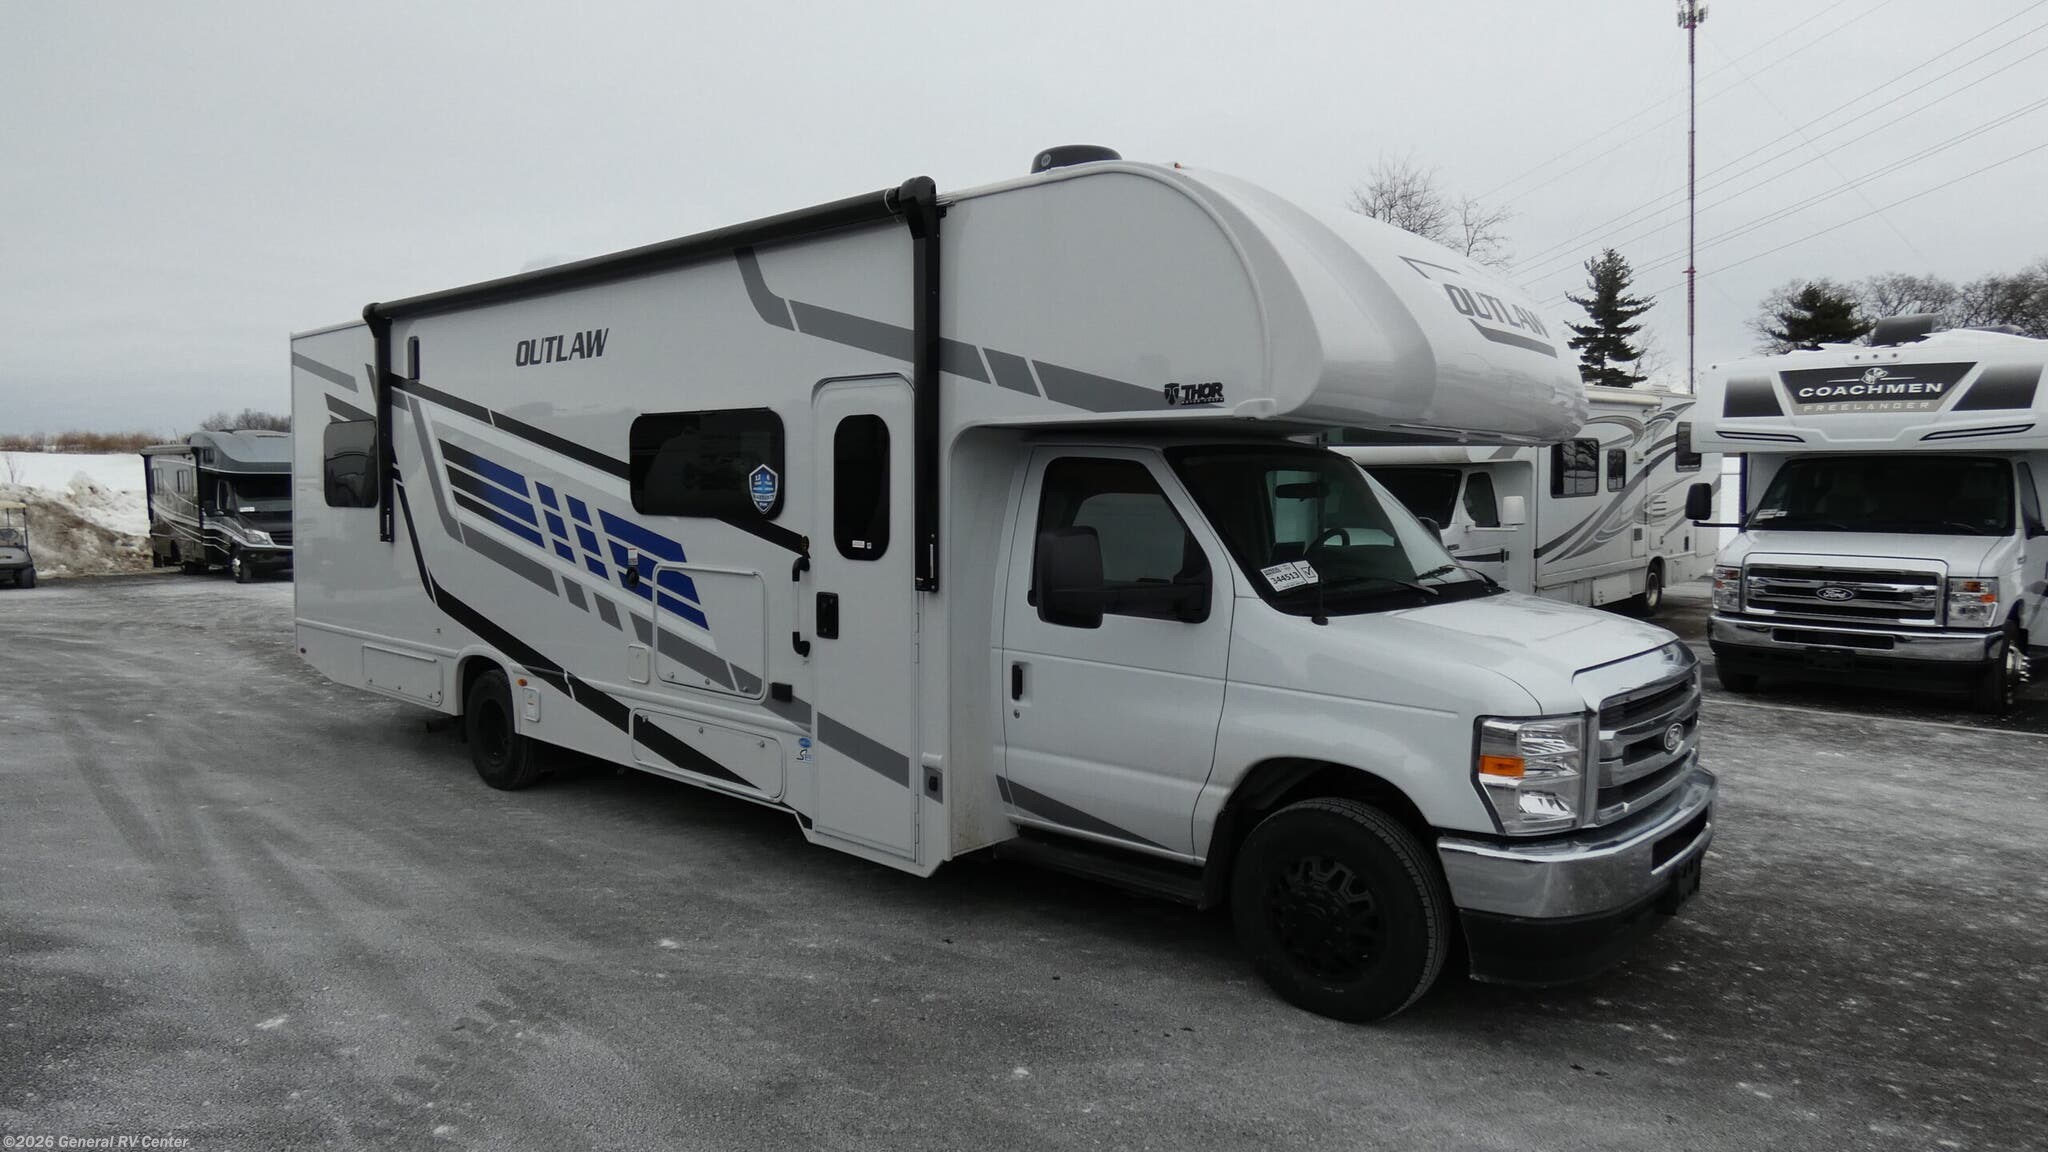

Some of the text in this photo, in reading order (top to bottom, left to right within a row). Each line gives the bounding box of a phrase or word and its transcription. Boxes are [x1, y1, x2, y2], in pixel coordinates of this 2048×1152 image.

[515, 327, 609, 367] OUTLAW
[1180, 382, 1224, 401] THOR
[1798, 382, 1944, 398] COACHMEN
[1803, 402, 1930, 412] FREELANDER
[1270, 571, 1300, 585] 344513
